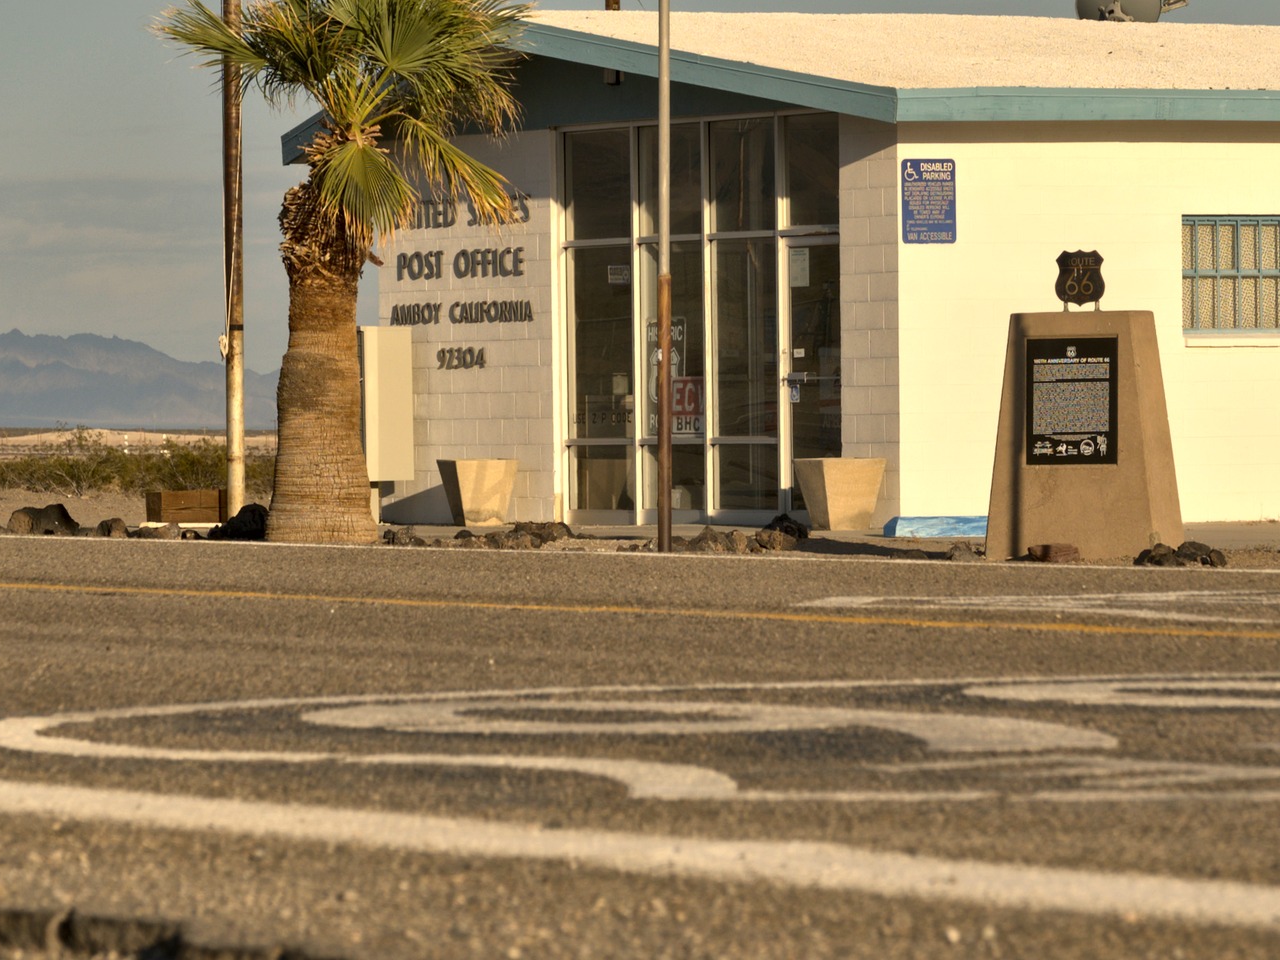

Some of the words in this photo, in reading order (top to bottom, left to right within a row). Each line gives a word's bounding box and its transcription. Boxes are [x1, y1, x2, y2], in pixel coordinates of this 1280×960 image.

[920, 162, 953, 171] DISABLED
[923, 172, 951, 180] PARKING
[907, 232, 918, 240] VAN
[920, 232, 953, 240] ACCESSIBLE
[396, 250, 444, 281] POST
[453, 246, 524, 279] OFFICE
[1065, 271, 1094, 295] 66
[390, 302, 442, 326] AMBOY
[448, 299, 534, 323] CALIFORNIA
[436, 346, 486, 370] 92304
[611, 409, 633, 425] CODE
[677, 416, 700, 431] BHC
